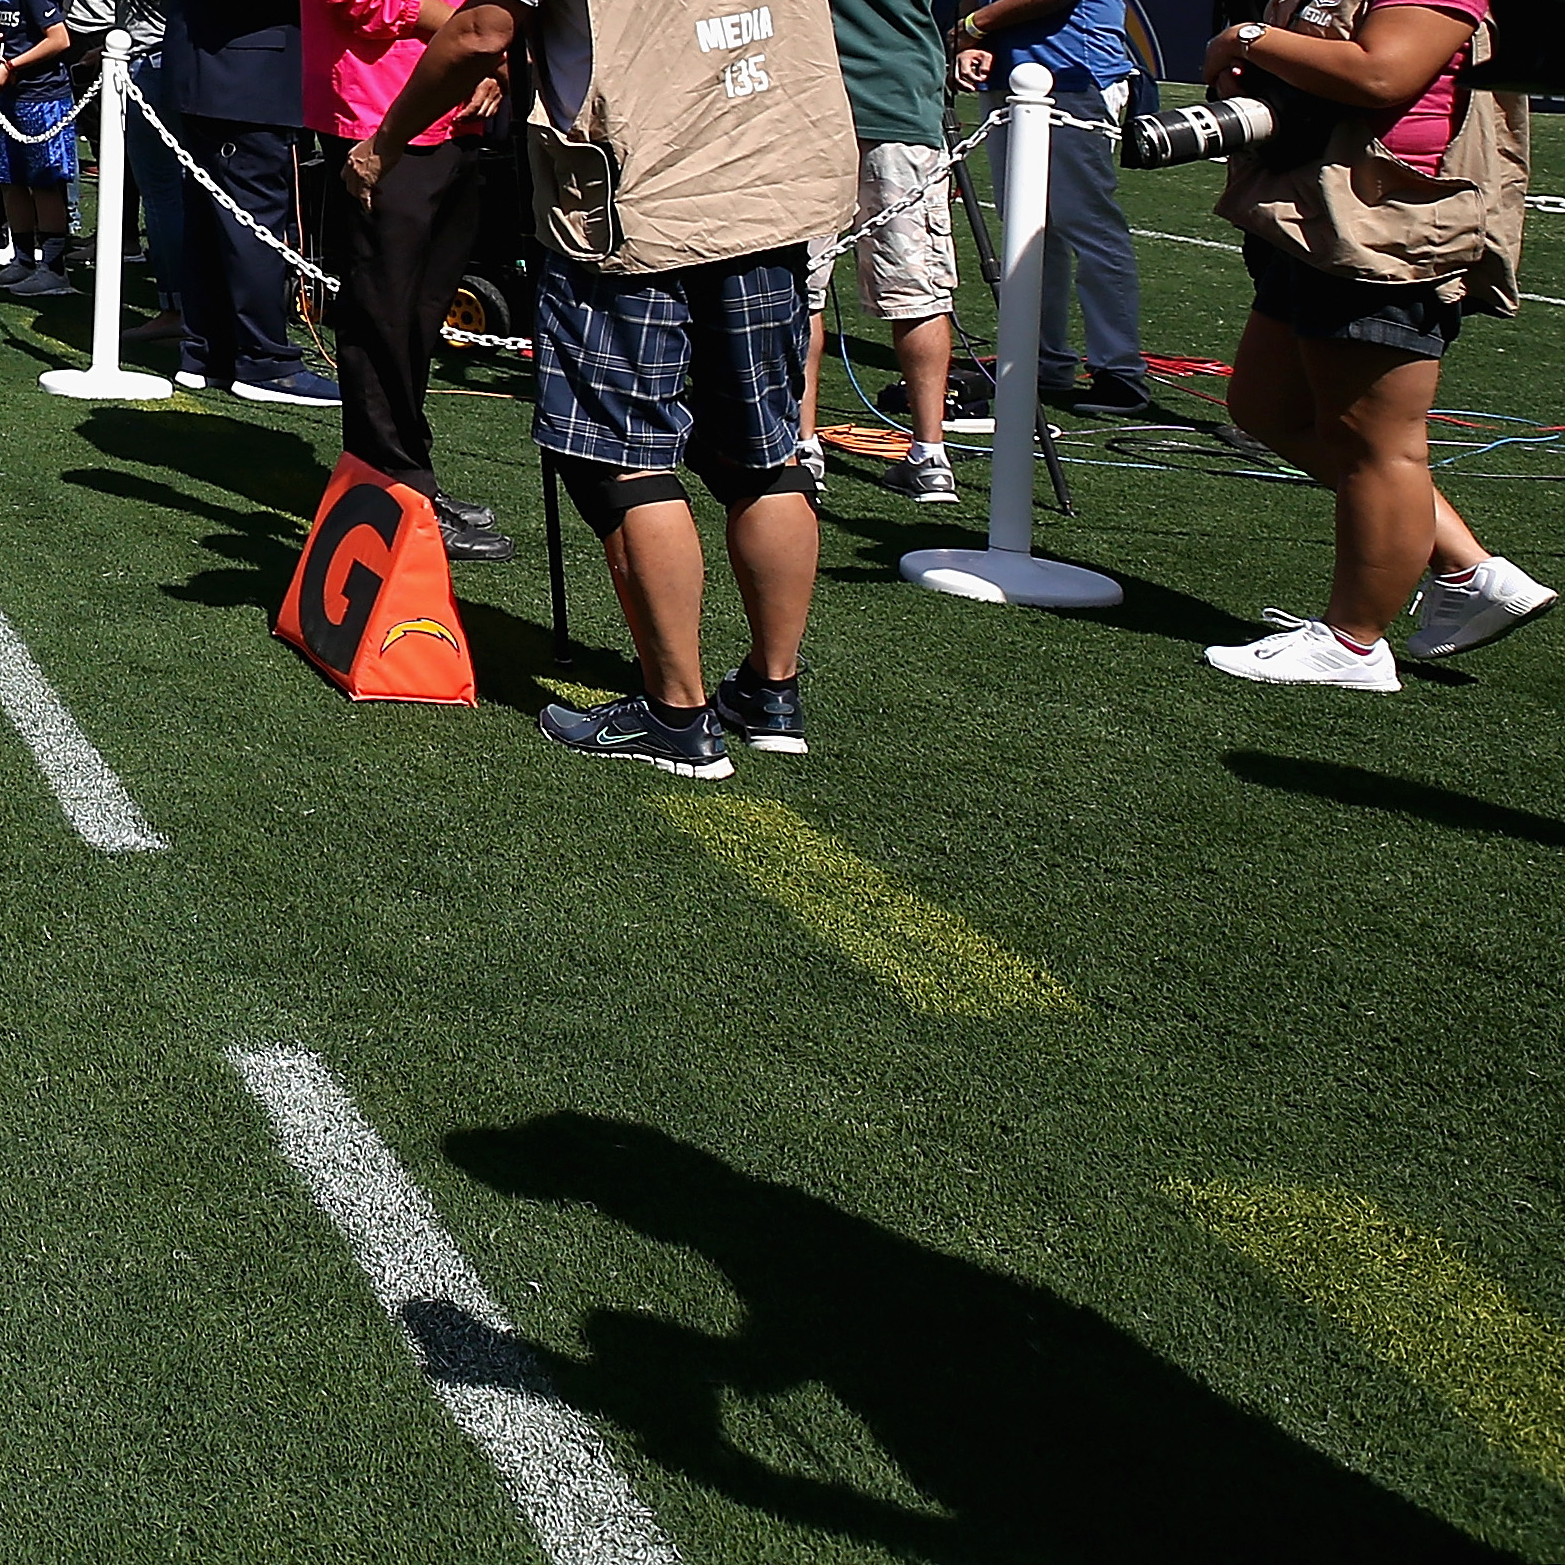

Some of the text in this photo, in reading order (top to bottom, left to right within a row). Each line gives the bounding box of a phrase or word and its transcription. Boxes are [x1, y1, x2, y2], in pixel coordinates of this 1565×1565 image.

[695, 6, 774, 53] MEDIA
[724, 54, 769, 98] 135
[299, 483, 404, 675] G
